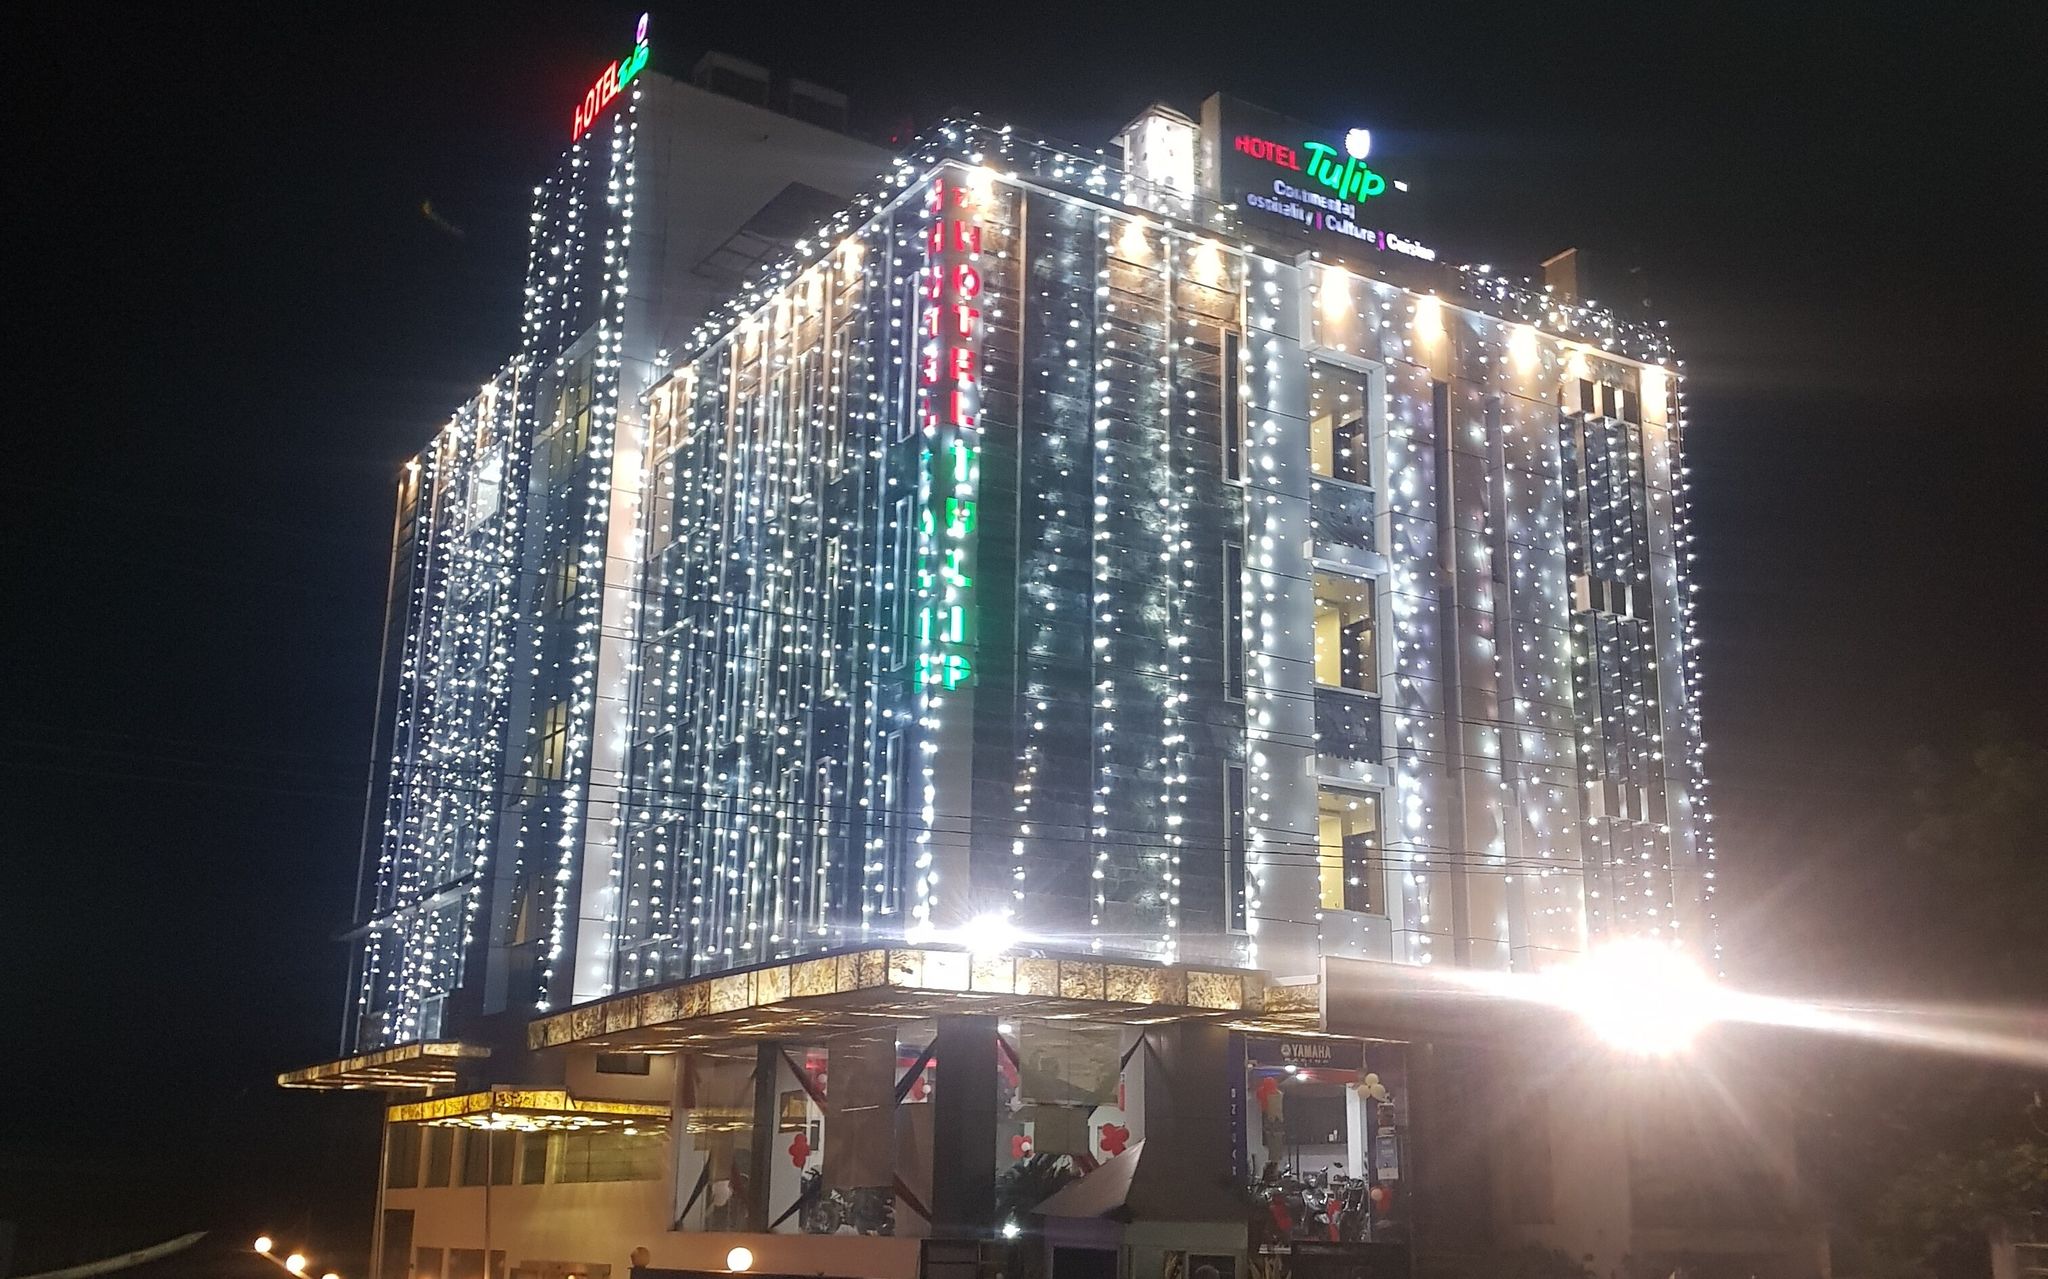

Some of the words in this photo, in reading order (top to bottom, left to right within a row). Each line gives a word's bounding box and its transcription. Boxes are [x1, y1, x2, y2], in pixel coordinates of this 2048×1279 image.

[572, 60, 619, 142] HOTEL
[1234, 134, 1300, 171] HOTEL
[1303, 140, 1386, 204] Tulip
[1324, 213, 1377, 244] Culture
[1385, 232, 1437, 262] Cuisine
[949, 219, 982, 428] HOTEL
[943, 445, 977, 692] TULIP
[1291, 1043, 1332, 1059] YAMAHA
